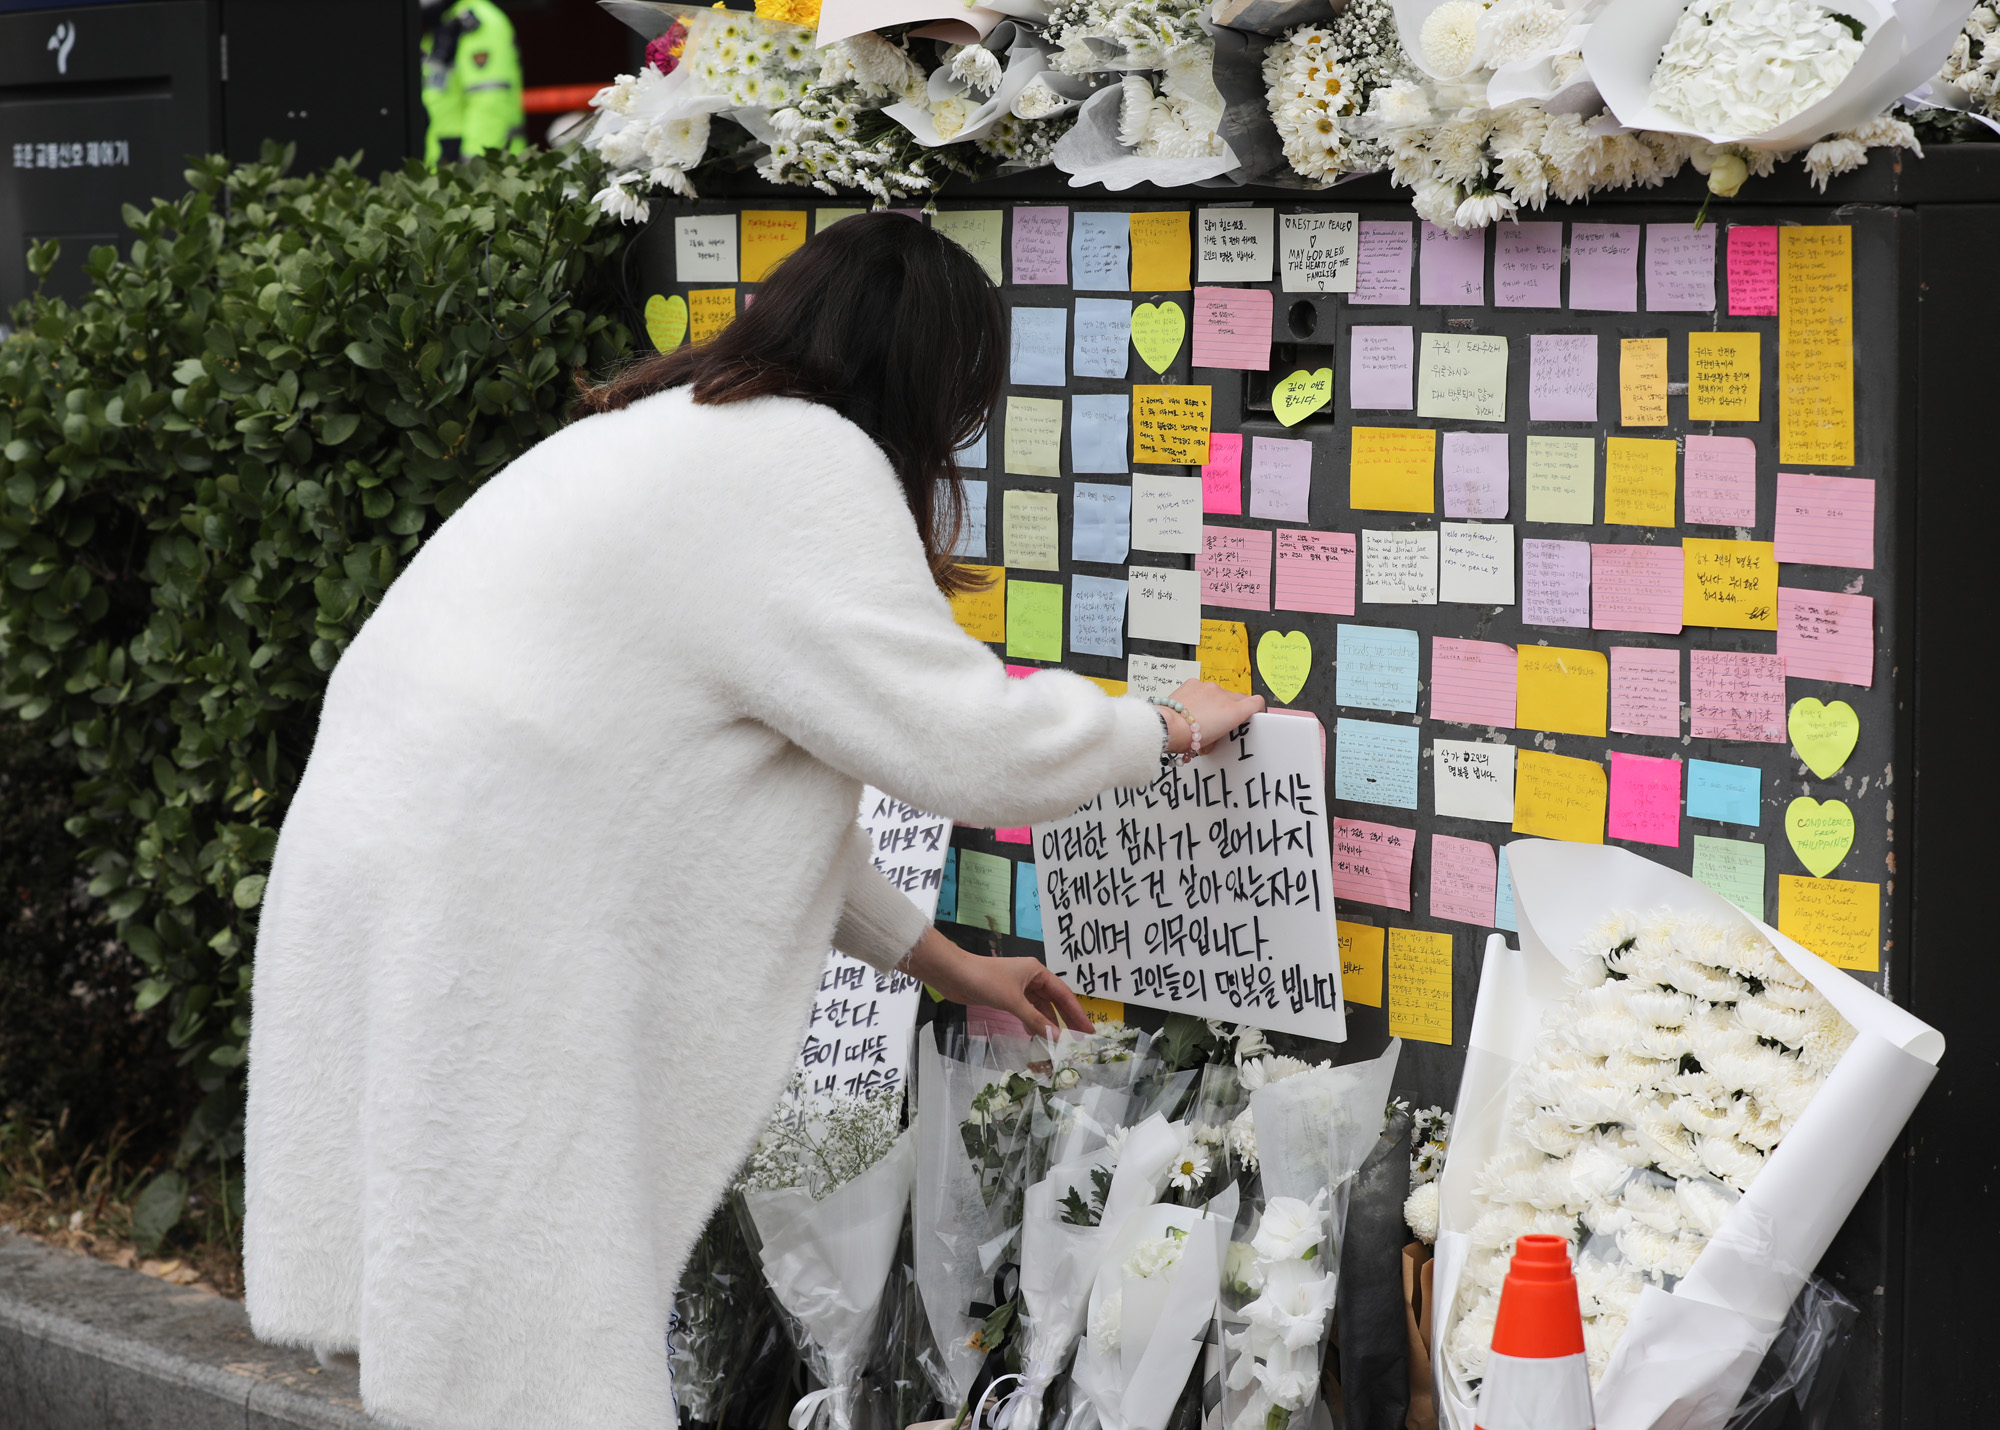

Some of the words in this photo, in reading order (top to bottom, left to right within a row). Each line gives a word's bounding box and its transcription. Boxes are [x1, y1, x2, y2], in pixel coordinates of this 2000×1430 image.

[36, 142, 84, 169] 교통신호
[87, 140, 130, 167] 제어기
[1293, 219, 1311, 234] REST
[1313, 219, 1326, 232] IN
[1203, 250, 1218, 262] 고인의
[1288, 249, 1304, 260] MAY
[1306, 249, 1323, 262] GOD
[1325, 246, 1345, 259] BLESS
[1288, 260, 1302, 271] THE
[1305, 259, 1326, 271] HEARTS
[1327, 260, 1337, 271] OF
[1339, 258, 1350, 268] THE
[1306, 268, 1337, 282] FAMILIES
[1696, 348, 1713, 358] 우리는
[1717, 348, 1736, 357] 안전한
[1431, 364, 1470, 378] 위로하시고
[1696, 359, 1734, 370] 대한민국에서
[1287, 381, 1305, 392] 깊이
[1310, 380, 1326, 391] 애도
[1698, 385, 1724, 395] 행복하게
[1432, 390, 1445, 401] 다시
[1447, 388, 1475, 402] 반복되지
[1697, 396, 1715, 406] 권리가
[1372, 537, 1384, 545] hope
[1382, 545, 1392, 553] and
[1448, 549, 1464, 560] hope
[1465, 554, 1479, 563] you
[1378, 561, 1389, 569] will
[1384, 571, 1397, 581] sorry
[1418, 570, 1424, 578] to
[1345, 663, 1355, 671] all
[1378, 662, 1385, 673] it
[1373, 678, 1400, 696] together
[1441, 748, 1460, 764] 삼가
[1522, 762, 1537, 773] MAY
[1540, 766, 1554, 777] THE
[1557, 768, 1574, 779] SOUL
[1578, 773, 1588, 783] OF
[1526, 773, 1540, 785] THE
[1542, 778, 1572, 794] FAITHFUL
[1244, 771, 1320, 816] 다시는
[1532, 786, 1553, 802] REST
[1555, 796, 1565, 806] IN
[1545, 810, 1569, 823] AMEN
[1797, 818, 1853, 829] CONDOLENCE
[878, 822, 945, 854] 바보짓
[1814, 829, 1838, 837] FROM
[1041, 819, 1107, 863] 이러한
[1115, 817, 1202, 866] 참사가
[1208, 817, 1315, 859] 일어나지
[1796, 836, 1851, 852] PHILIPPINES
[1793, 878, 1804, 889] Be
[1839, 883, 1857, 894] Lord
[1794, 890, 1822, 904] Jesus
[1794, 908, 1813, 921] May
[1814, 909, 1829, 919] the
[1057, 911, 1132, 963] 몫이며
[1144, 913, 1274, 962] 의무입니다.
[1830, 940, 1856, 955] mercy
[1075, 962, 1121, 996] 삼가
[1130, 962, 1208, 1002] 고인들의
[1214, 964, 1281, 1009] 명복을
[1281, 963, 1338, 1015] 빕니다
[844, 1034, 889, 1067] 따뜻
[814, 1073, 837, 1098] 내
